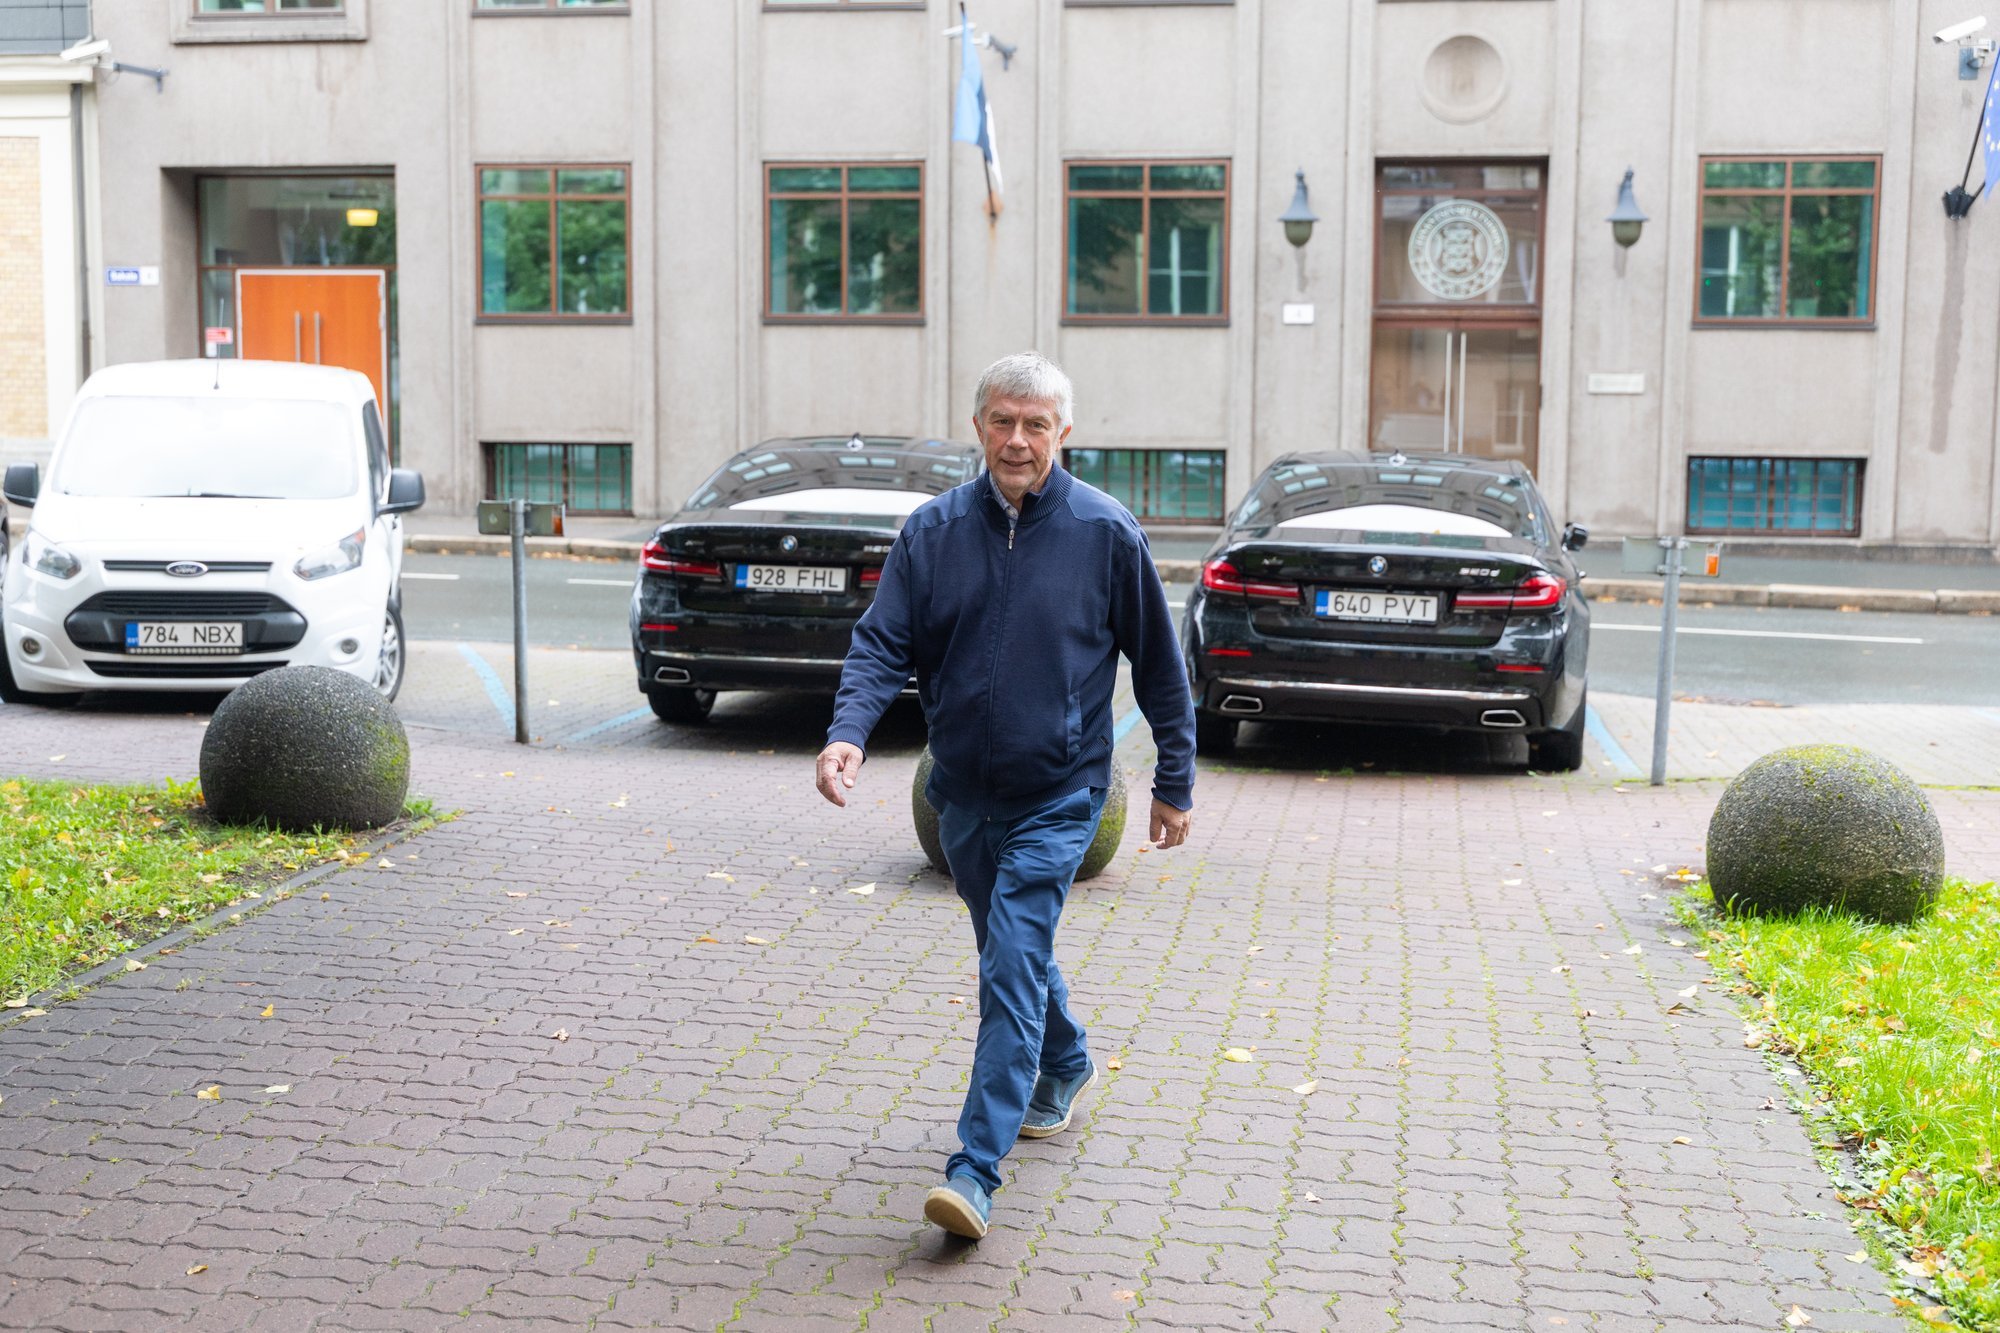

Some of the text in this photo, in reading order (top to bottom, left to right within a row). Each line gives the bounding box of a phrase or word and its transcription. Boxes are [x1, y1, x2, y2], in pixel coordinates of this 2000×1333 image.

[752, 567, 839, 588] 928 FHL
[1333, 594, 1431, 618] 640 PVT
[143, 625, 236, 643] 784 NBX
